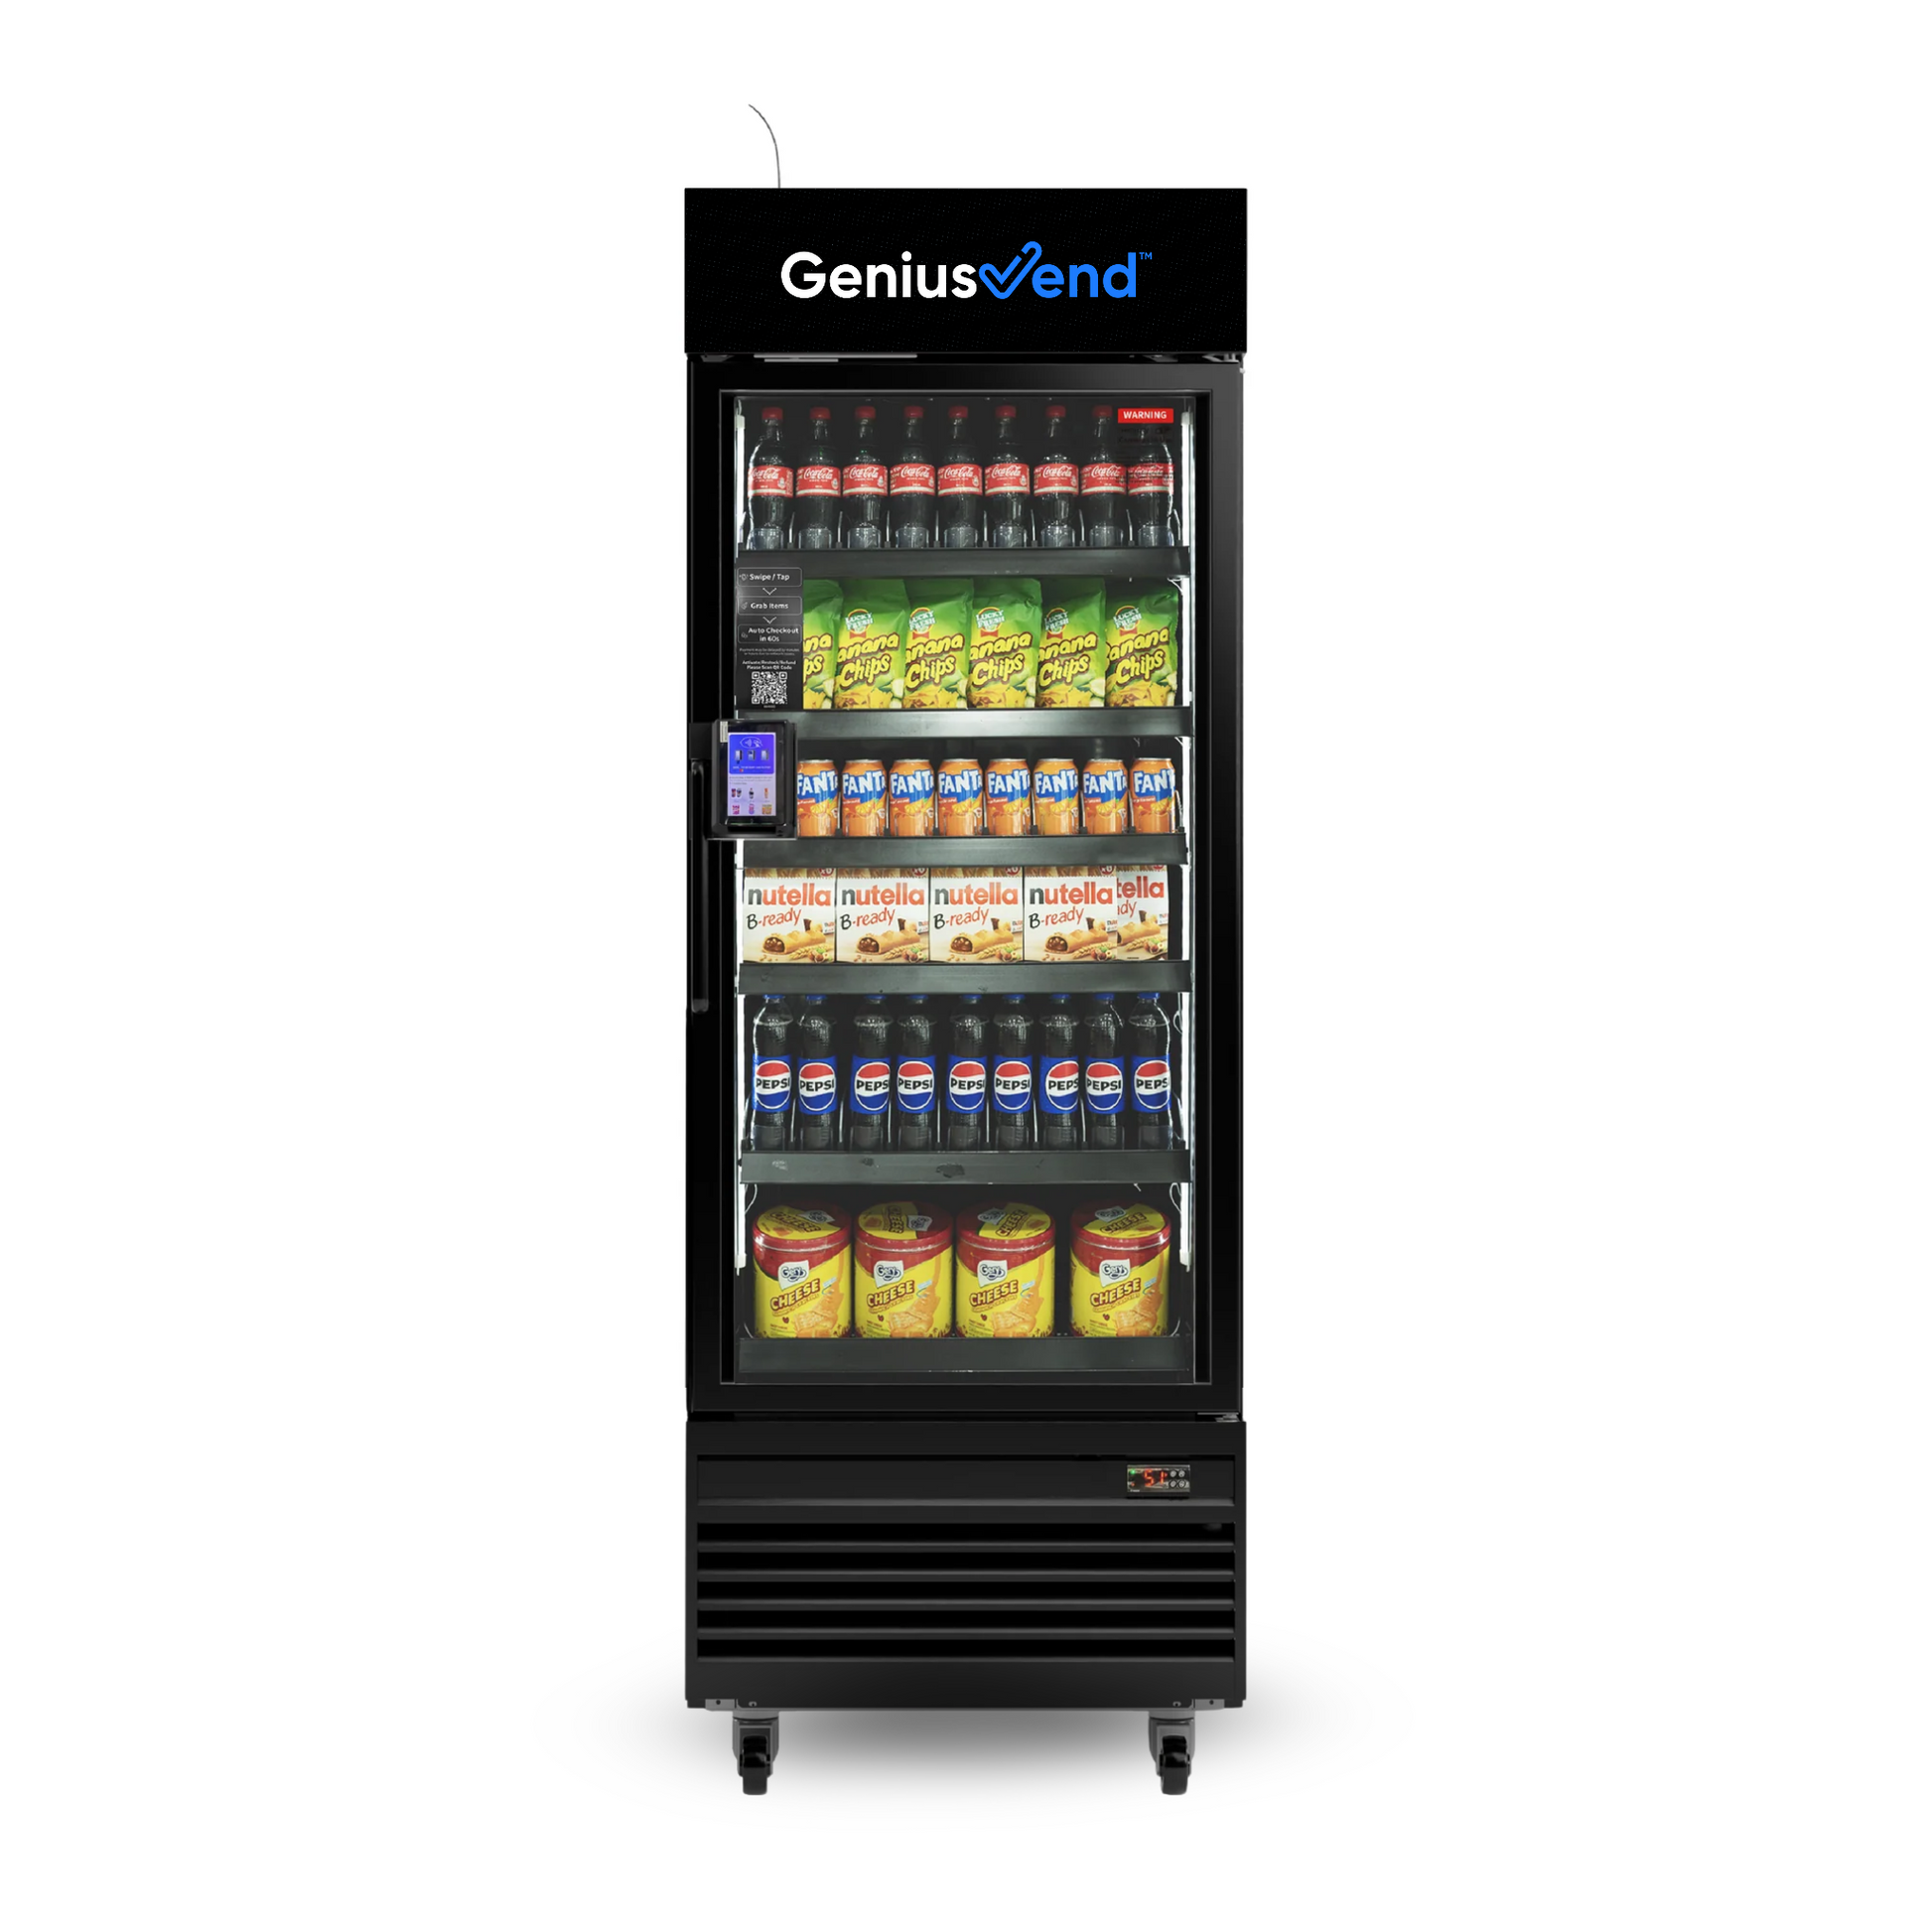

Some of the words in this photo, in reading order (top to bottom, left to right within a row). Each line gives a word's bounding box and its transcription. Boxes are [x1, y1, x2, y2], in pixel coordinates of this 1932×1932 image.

[840, 653, 893, 689] Chips
[905, 654, 956, 689] Chips
[972, 653, 1025, 686] Chips
[1038, 654, 1090, 687] Chips
[1116, 648, 1165, 685] Chips
[749, 883, 831, 906] nutella
[842, 883, 924, 905] nutella
[934, 882, 1018, 905] nutella
[1030, 882, 1113, 905] nutella
[747, 907, 802, 930] B-ready
[840, 907, 896, 930] B-ready
[933, 906, 989, 929] B-ready
[1028, 905, 1084, 929] B-ready
[1086, 1078, 1122, 1091] PEPSI
[770, 1278, 820, 1311] CHEESE
[867, 1280, 914, 1308] CHEESE
[969, 1279, 1019, 1307] CHEESE
[1090, 1277, 1141, 1307] CHEESE
